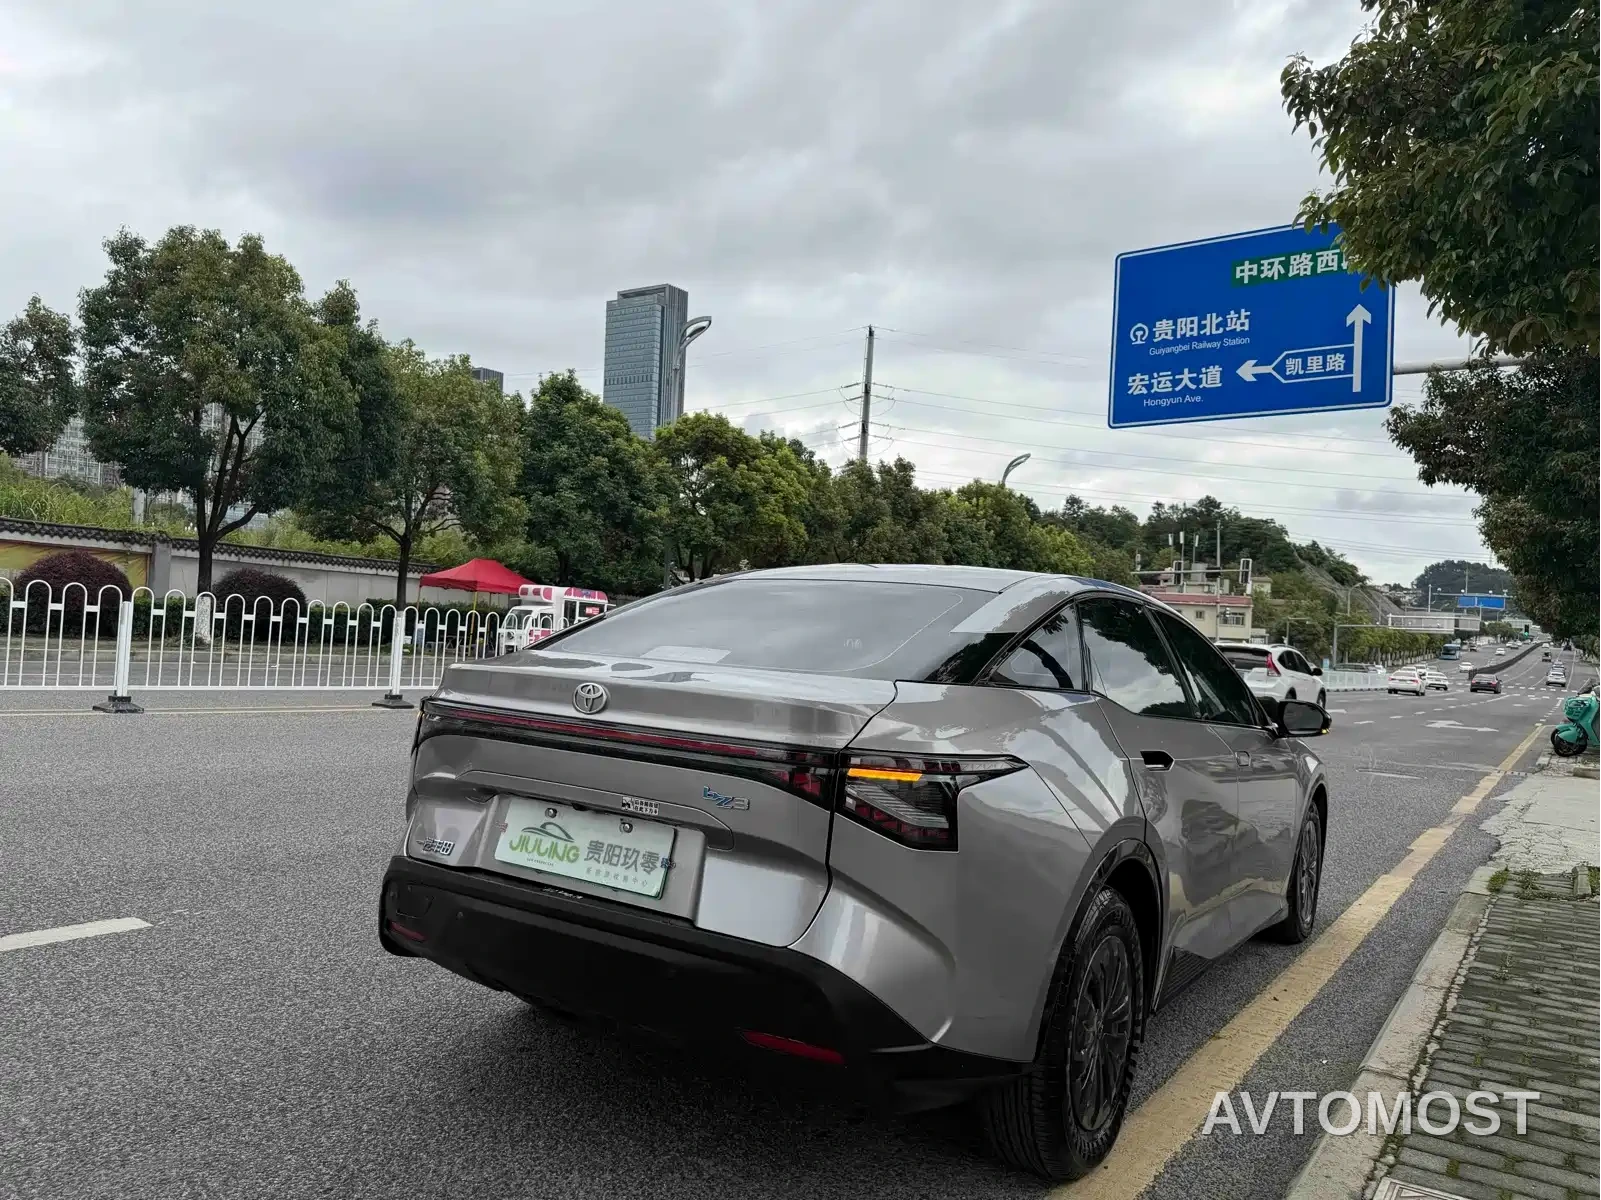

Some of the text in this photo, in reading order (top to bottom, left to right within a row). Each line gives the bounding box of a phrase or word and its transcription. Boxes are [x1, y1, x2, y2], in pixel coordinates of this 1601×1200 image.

[1235, 248, 1348, 284] 中环路西
[1152, 308, 1251, 342] 贵阳北站
[1149, 336, 1250, 356] Guiyangbei Railway Station
[1285, 353, 1346, 376] 凯里路
[1127, 365, 1223, 395] 宏运大道
[1143, 394, 1204, 408] Hongyun Ave.
[509, 834, 580, 864] JIULING
[584, 840, 660, 875] 贵阳玖零
